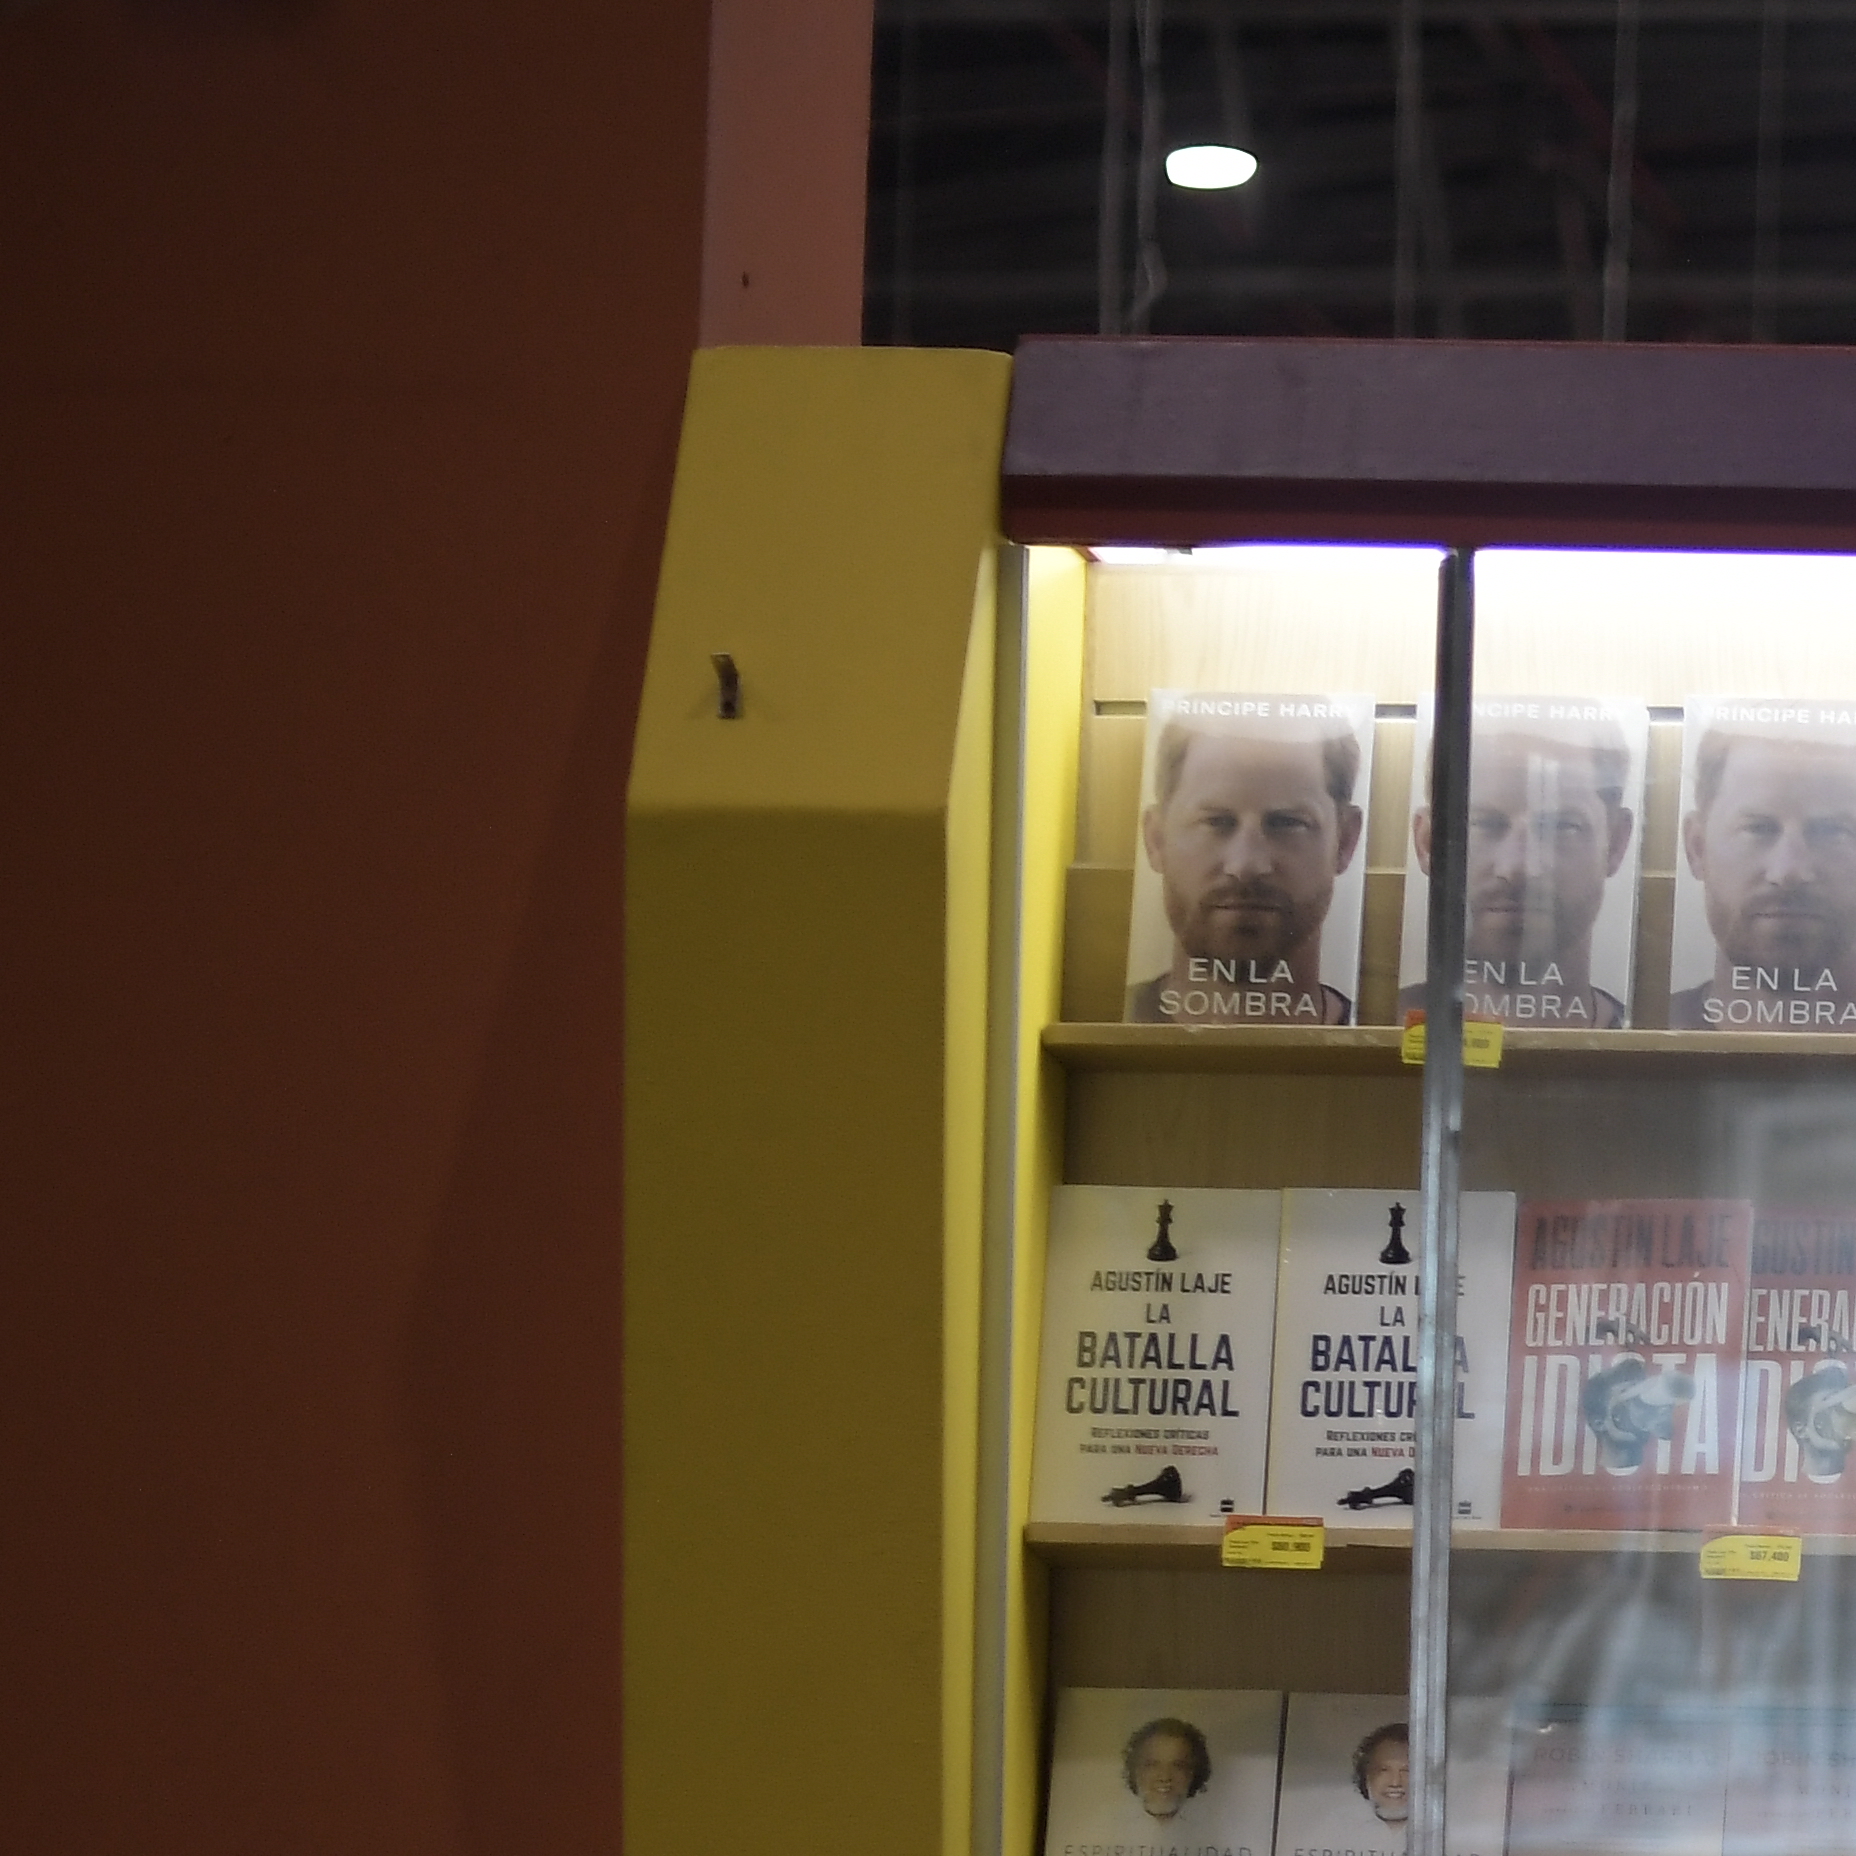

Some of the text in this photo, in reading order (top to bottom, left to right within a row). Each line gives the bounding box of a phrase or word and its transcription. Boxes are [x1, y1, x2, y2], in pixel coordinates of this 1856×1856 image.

[1188, 959, 1295, 984] EN LA
[1730, 967, 1838, 993] EN LA
[1158, 991, 1318, 1016] SOMBRA
[1091, 1268, 1232, 1294] AGUSTÍN LAJE
[1146, 1303, 1171, 1324] LA
[1525, 1272, 1729, 1347] GENERACIÓN
[1076, 1331, 1235, 1372] BATALLA
[1065, 1377, 1240, 1417] CULTURAL
